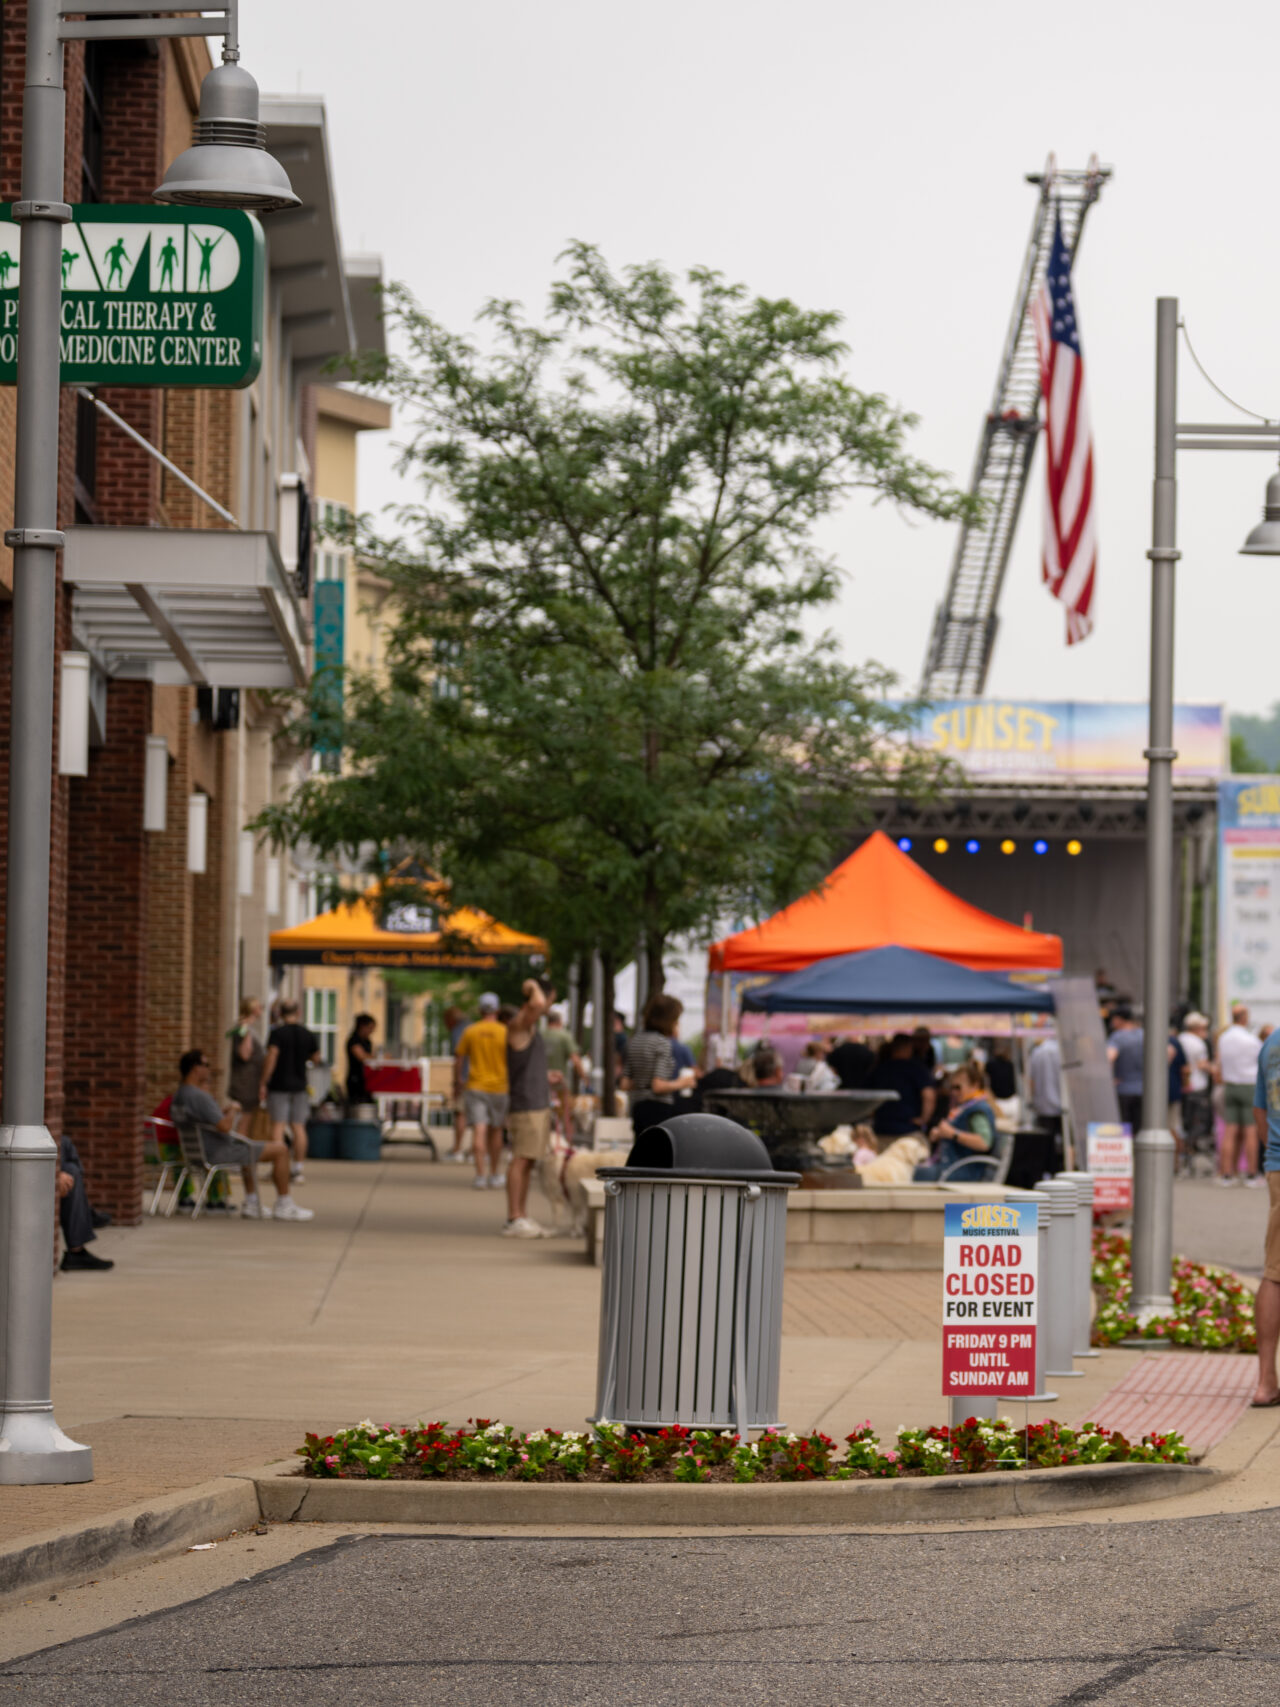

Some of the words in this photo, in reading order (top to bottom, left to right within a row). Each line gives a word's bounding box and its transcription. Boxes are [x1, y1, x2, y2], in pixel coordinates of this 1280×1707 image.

[3, 299, 101, 329] PCAL
[103, 300, 197, 331] THERAPY
[200, 303, 216, 331] &
[59, 335, 156, 365] MEDICINE
[160, 336, 241, 367] CENTER
[932, 704, 1059, 751] SUNSET
[961, 1205, 1021, 1228] SUNSET
[962, 1228, 986, 1237] MUSIC
[987, 1228, 1019, 1237] FESTIVAL
[959, 1244, 1022, 1267] ROAD
[945, 1273, 1035, 1296] CLOSED
[946, 1301, 978, 1318] FOR
[983, 1301, 1035, 1318] EVENT
[947, 1334, 996, 1349] FRIDAY
[998, 1334, 1008, 1349] 9
[1010, 1334, 1032, 1349] PM
[969, 1352, 1010, 1367] UNTIL
[949, 1371, 1005, 1386] SUNDAY
[1007, 1371, 1029, 1386] AM
